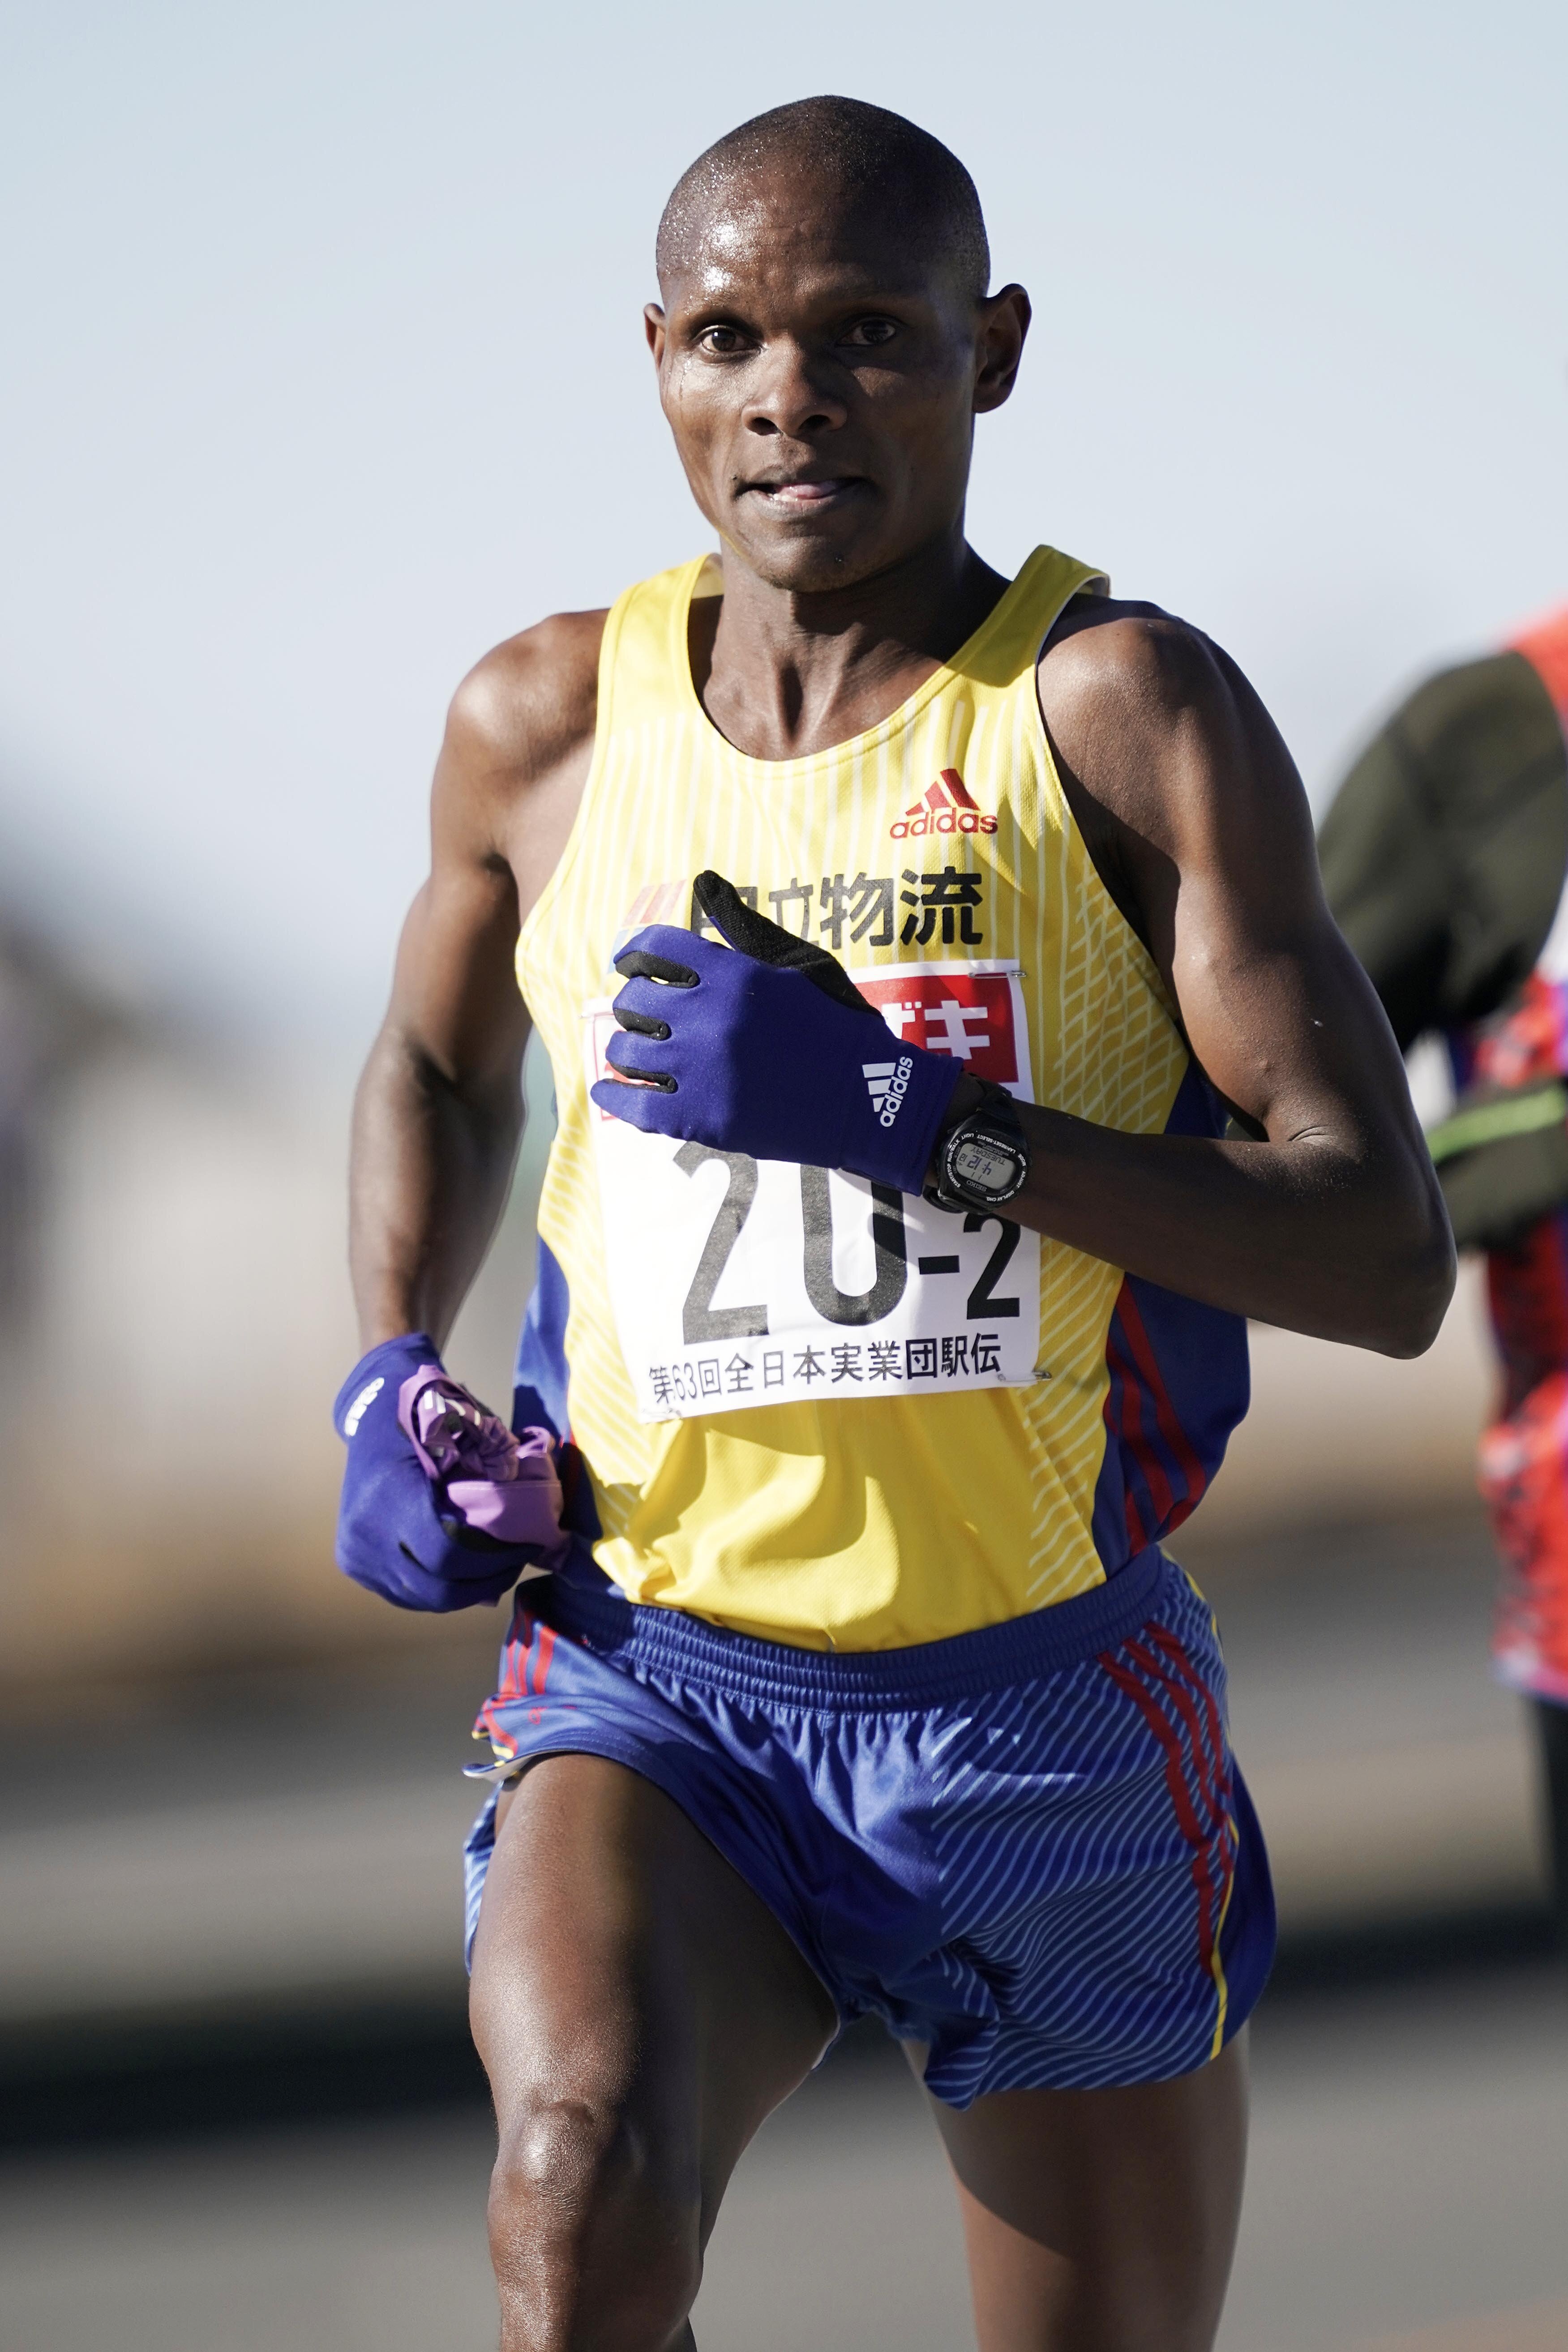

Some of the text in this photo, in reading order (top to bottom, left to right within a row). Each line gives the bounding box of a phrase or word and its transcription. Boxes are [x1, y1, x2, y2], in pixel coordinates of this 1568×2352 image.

[890, 807, 998, 839] adidas
[880, 1056, 913, 1128] adidas
[971, 1147, 1005, 1165] TUESDAY
[1018, 1153, 1026, 1166] MODE
[947, 1163, 961, 1188] START/STOP
[1016, 1171, 1026, 1188] ADJUST
[966, 1180, 988, 1192] SEIKO
[997, 1190, 1015, 1202] DISPLAY
[649, 1332, 1002, 1405] 第63回全日本実業団駅伝
